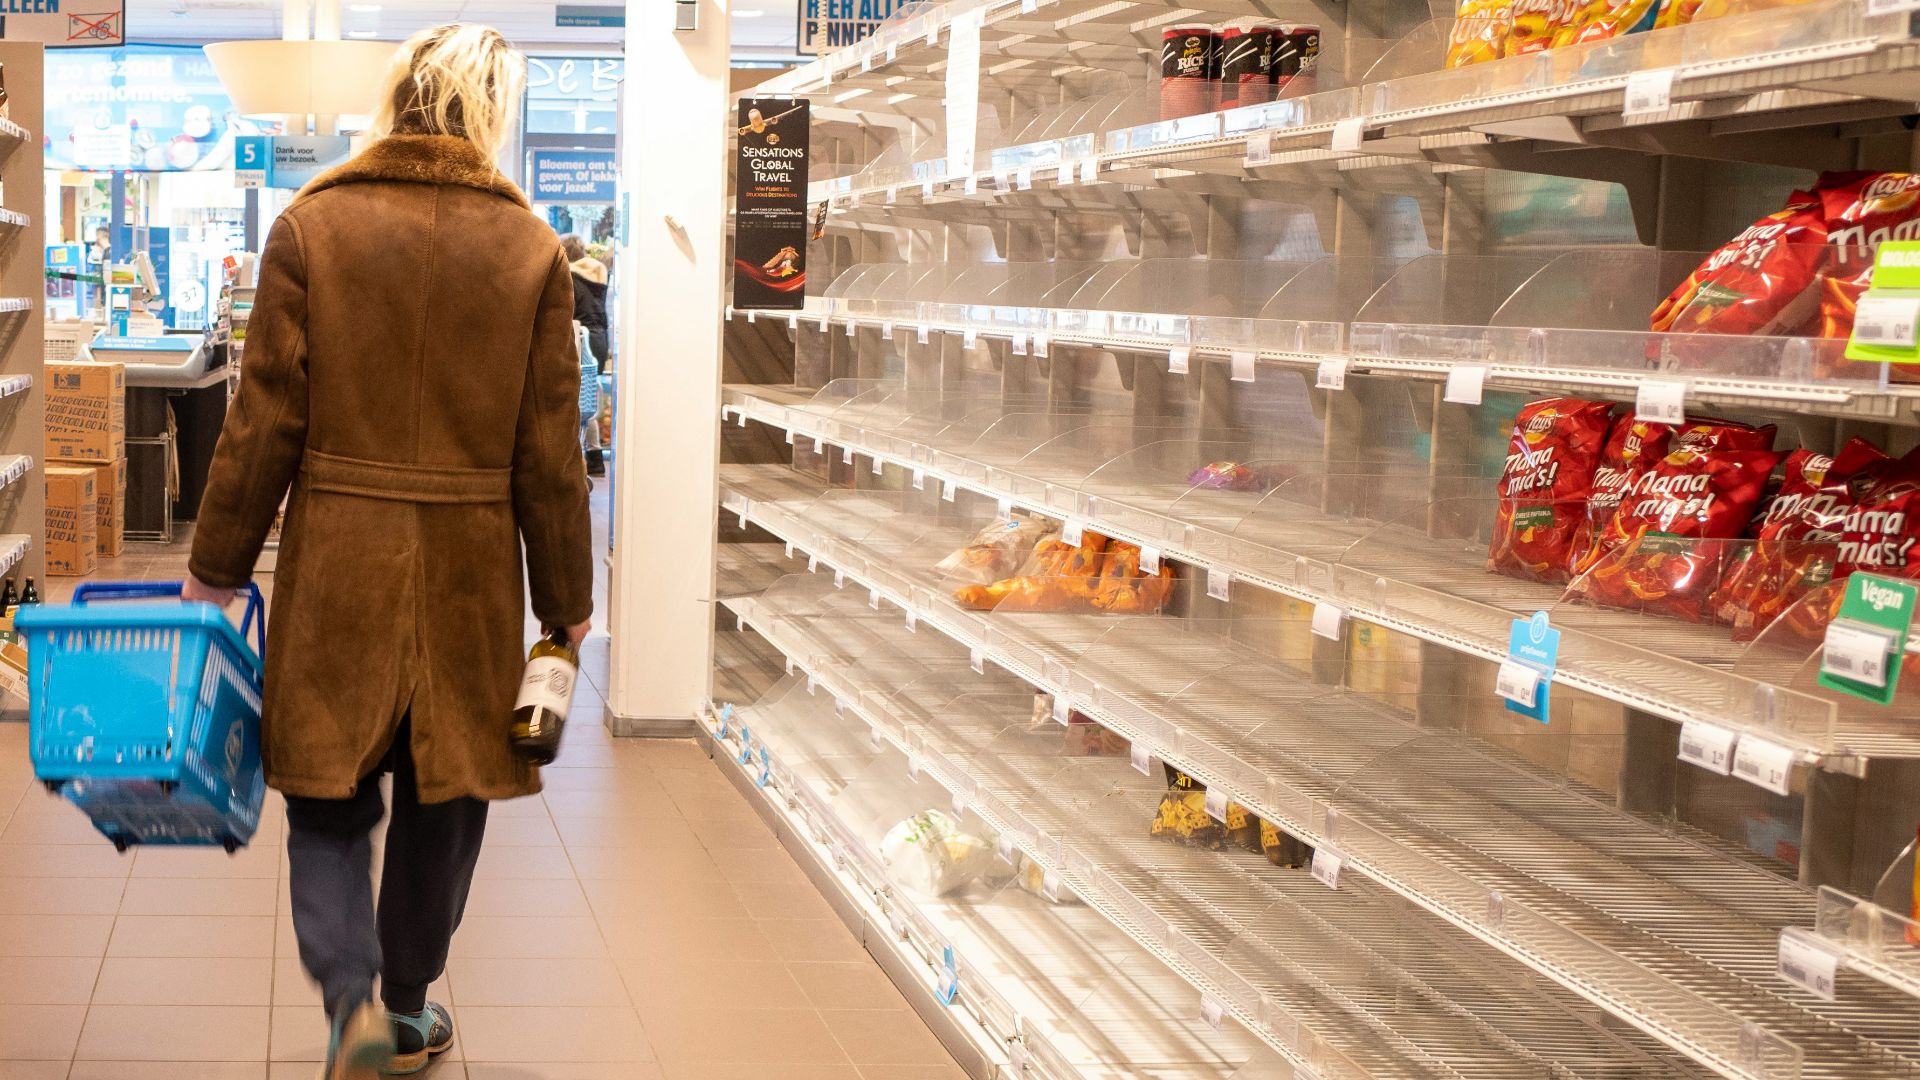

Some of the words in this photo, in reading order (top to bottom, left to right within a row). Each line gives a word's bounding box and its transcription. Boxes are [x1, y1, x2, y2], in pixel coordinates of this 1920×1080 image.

[1177, 54, 1205, 70] RICE
[244, 143, 256, 164] 5
[275, 147, 295, 155] Dank
[275, 156, 288, 164] uw
[539, 159, 586, 170] Bloemen
[587, 160, 606, 170] om
[539, 171, 574, 184] geven.
[575, 171, 591, 182] Of
[539, 183, 564, 193] voor
[564, 182, 597, 195] jezelf.
[1860, 579, 1904, 611] Vegan
